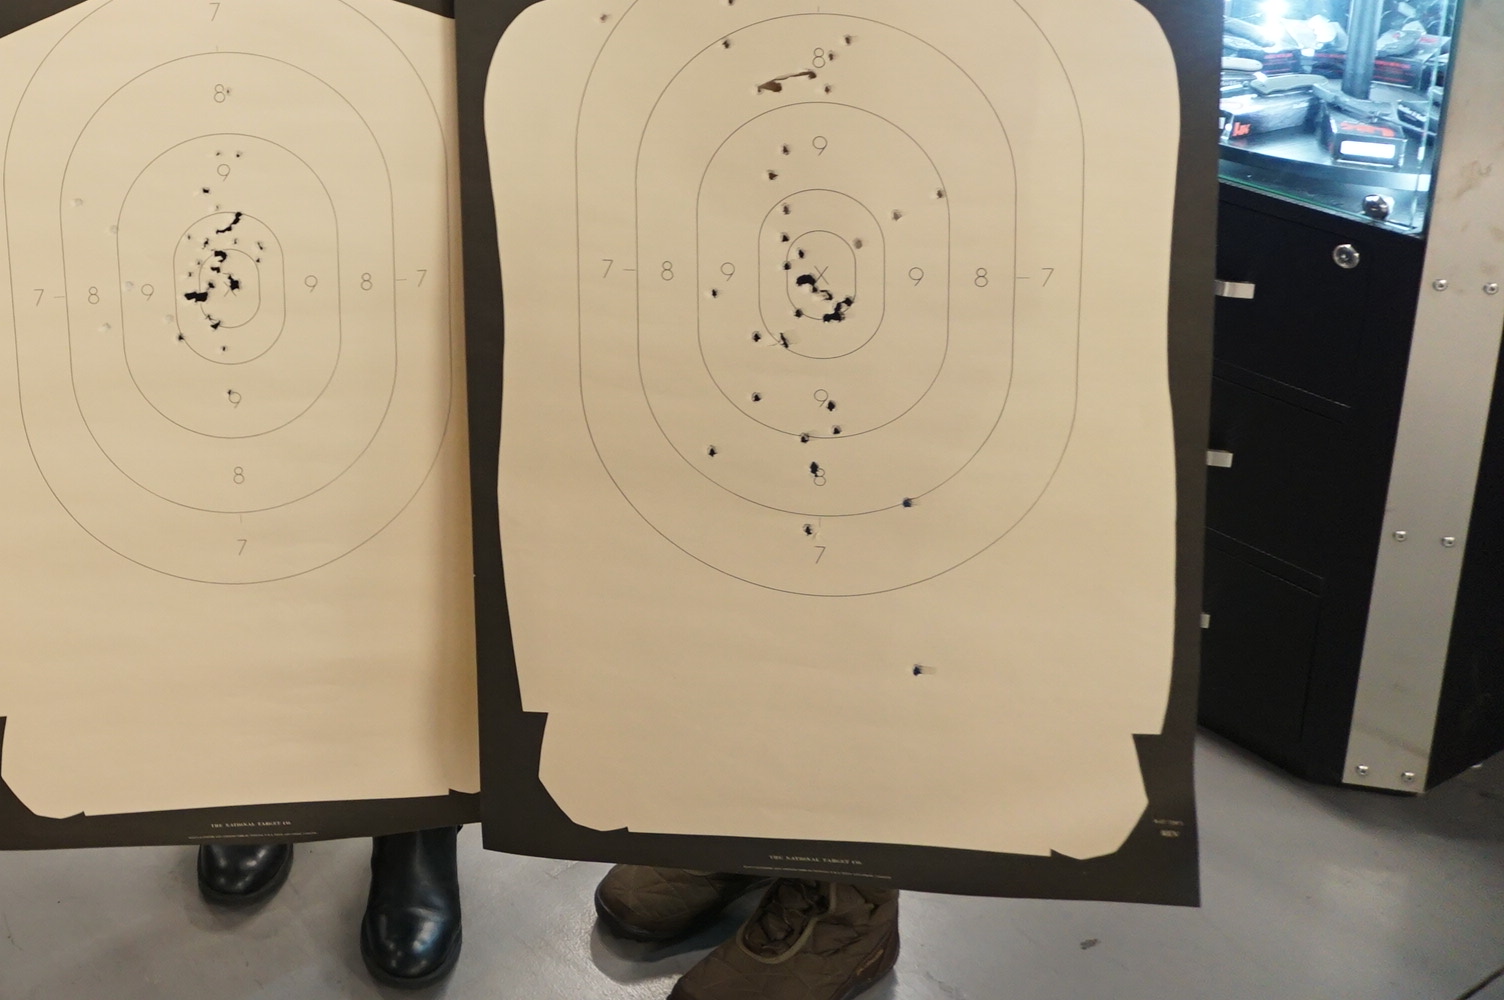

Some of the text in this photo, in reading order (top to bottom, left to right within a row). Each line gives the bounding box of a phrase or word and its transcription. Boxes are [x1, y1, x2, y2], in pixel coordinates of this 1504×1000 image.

[208, 2, 221, 22] 7
[811, 47, 826, 68] 8
[213, 83, 226, 104] 8
[811, 135, 828, 157] 9
[216, 163, 232, 182] 9
[415, 268, 428, 288] 7
[601, 258, 615, 279] 7
[661, 259, 674, 282] 8
[719, 261, 736, 282] 9
[907, 266, 925, 288] 9
[974, 267, 988, 288] 8
[1040, 267, 1054, 288] 7
[303, 274, 318, 294] 9
[360, 272, 373, 292] 8
[33, 288, 45, 307] 7
[87, 286, 100, 305] 8
[140, 283, 155, 302] 9
[228, 391, 242, 408] 9
[813, 388, 829, 408] 9
[232, 466, 246, 485] 8
[236, 538, 248, 557] 7
[813, 544, 827, 565] 7
